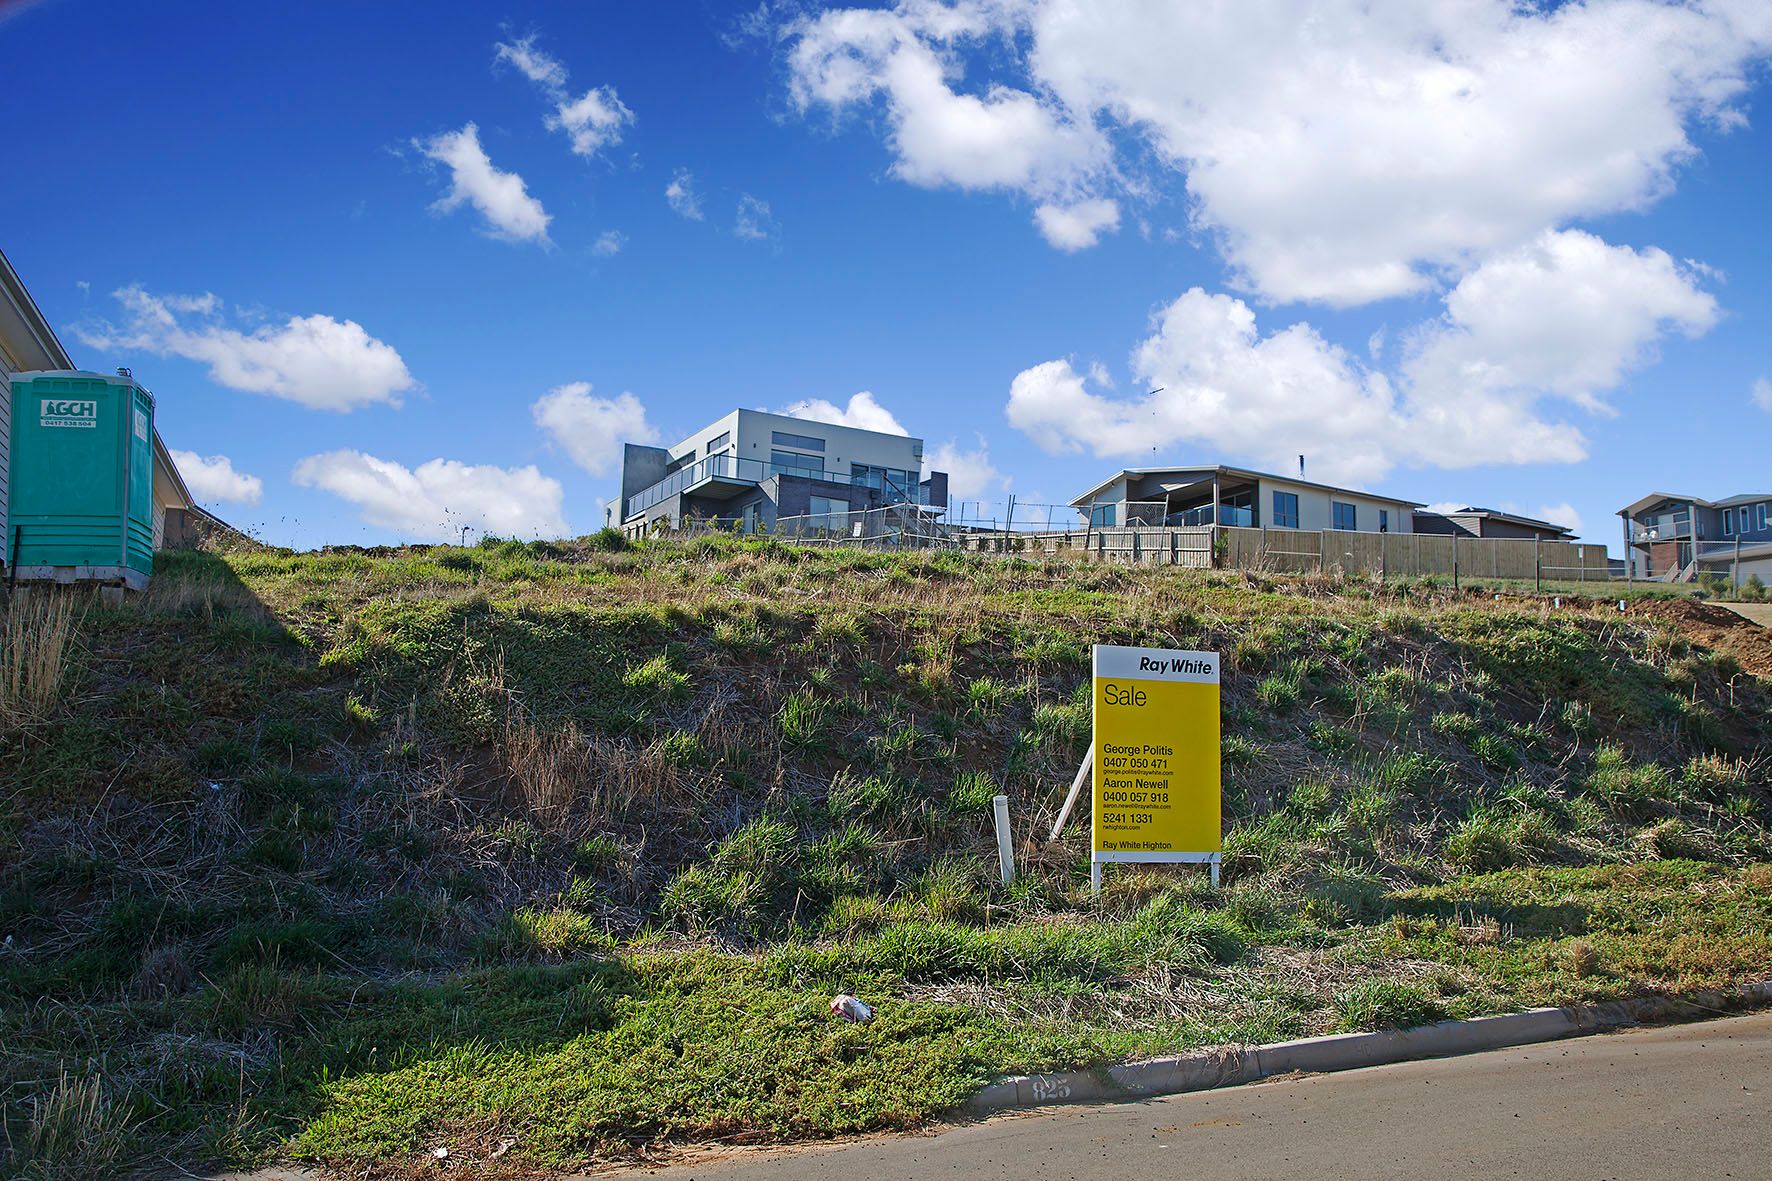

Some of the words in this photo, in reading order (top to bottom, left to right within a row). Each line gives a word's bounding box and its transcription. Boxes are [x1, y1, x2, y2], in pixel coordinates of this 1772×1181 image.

[1140, 657, 1168, 674] Ray
[1171, 659, 1212, 675] White
[1104, 684, 1147, 706] Sale
[1103, 743, 1140, 756] George
[1143, 745, 1173, 756] Politis
[1103, 757, 1127, 767] 0407
[1130, 758, 1148, 768] 050
[1151, 759, 1168, 769] 471
[1103, 778, 1132, 788] Aaron
[1135, 779, 1168, 789] Newell
[1103, 791, 1127, 802] 0400
[1130, 792, 1147, 802] 057
[1151, 793, 1169, 803] 918
[1103, 813, 1126, 823] 5241
[1130, 814, 1152, 823] 1331
[1103, 841, 1118, 850] Ray
[1119, 841, 1140, 849] White
[1142, 841, 1172, 850] Highton
[1032, 1078, 1071, 1101] 825
